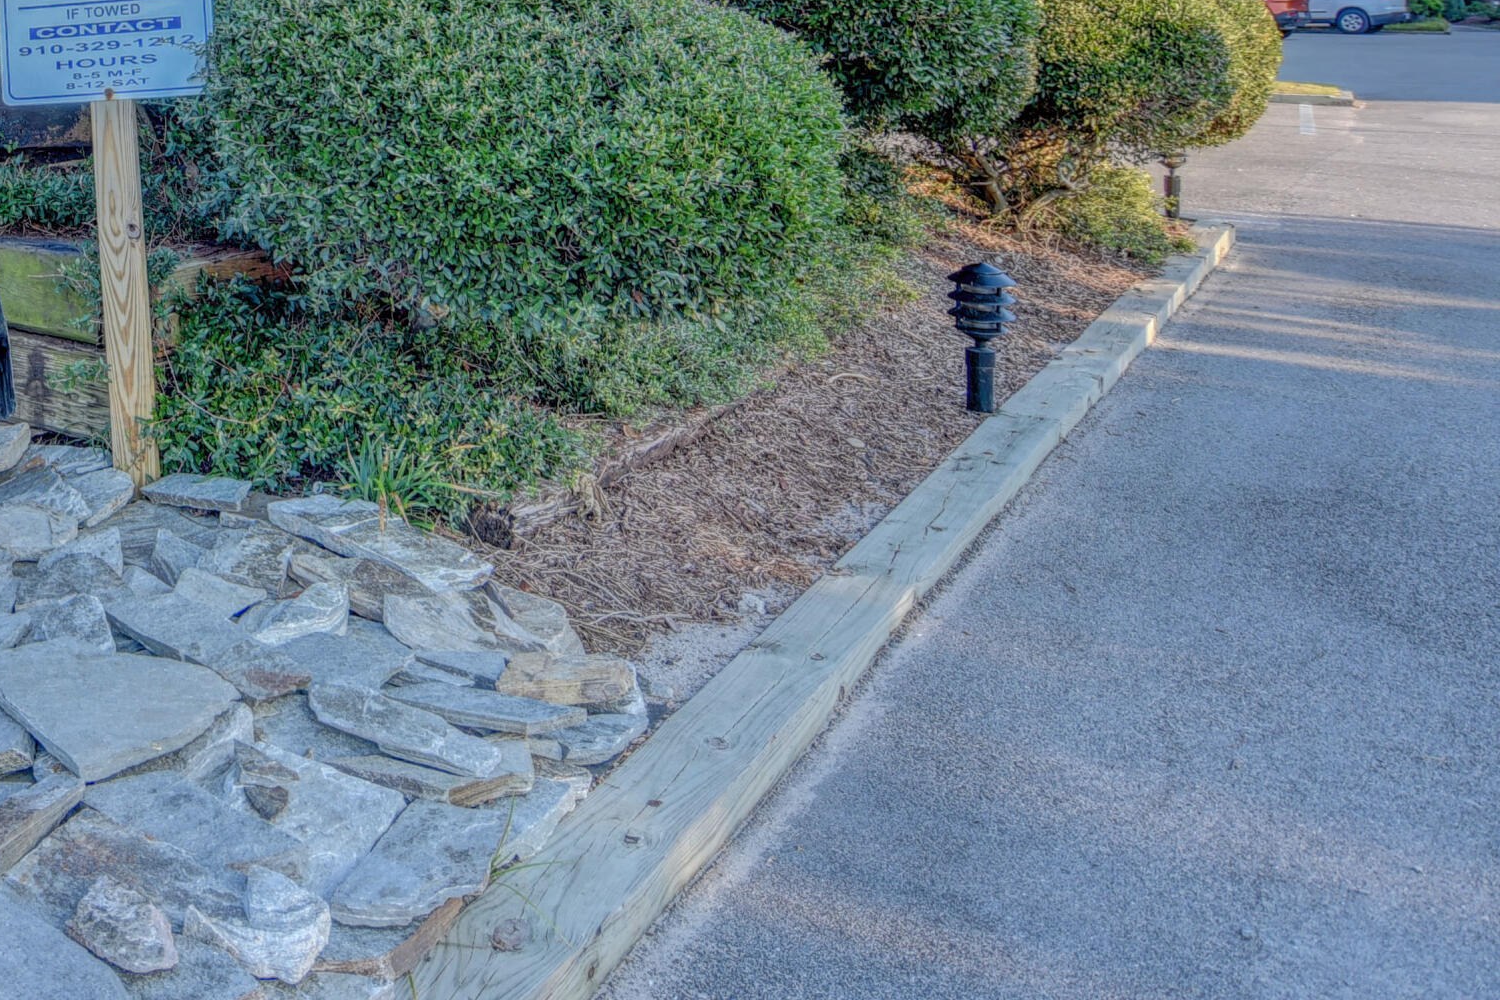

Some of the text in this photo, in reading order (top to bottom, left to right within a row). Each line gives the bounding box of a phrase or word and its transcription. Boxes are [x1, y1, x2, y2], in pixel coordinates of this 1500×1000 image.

[67, 4, 141, 19] IF TOWED
[36, 18, 174, 38] CONTACT
[19, 35, 194, 56] 910-329-1212
[56, 54, 157, 70] HOURS
[73, 68, 142, 80] 8-5 M-F
[66, 77, 149, 90] 8-12 SAT
